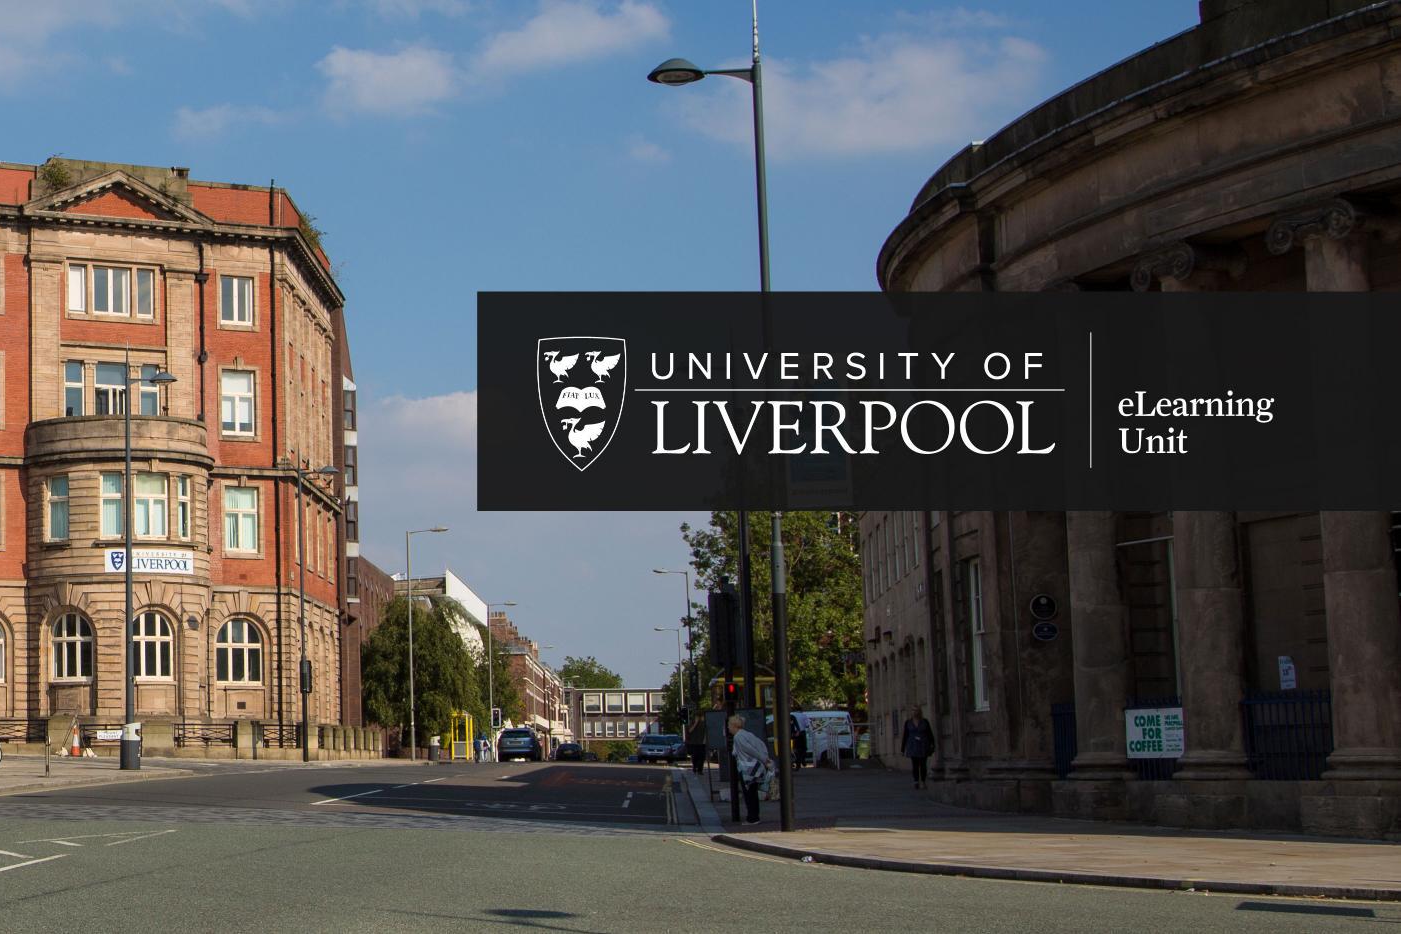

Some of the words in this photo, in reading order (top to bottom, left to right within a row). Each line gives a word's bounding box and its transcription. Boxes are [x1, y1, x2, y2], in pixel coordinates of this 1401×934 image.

[1135, 715, 1161, 727] COME
[1142, 728, 1162, 739] FOR
[1129, 740, 1163, 752] COFFEE
